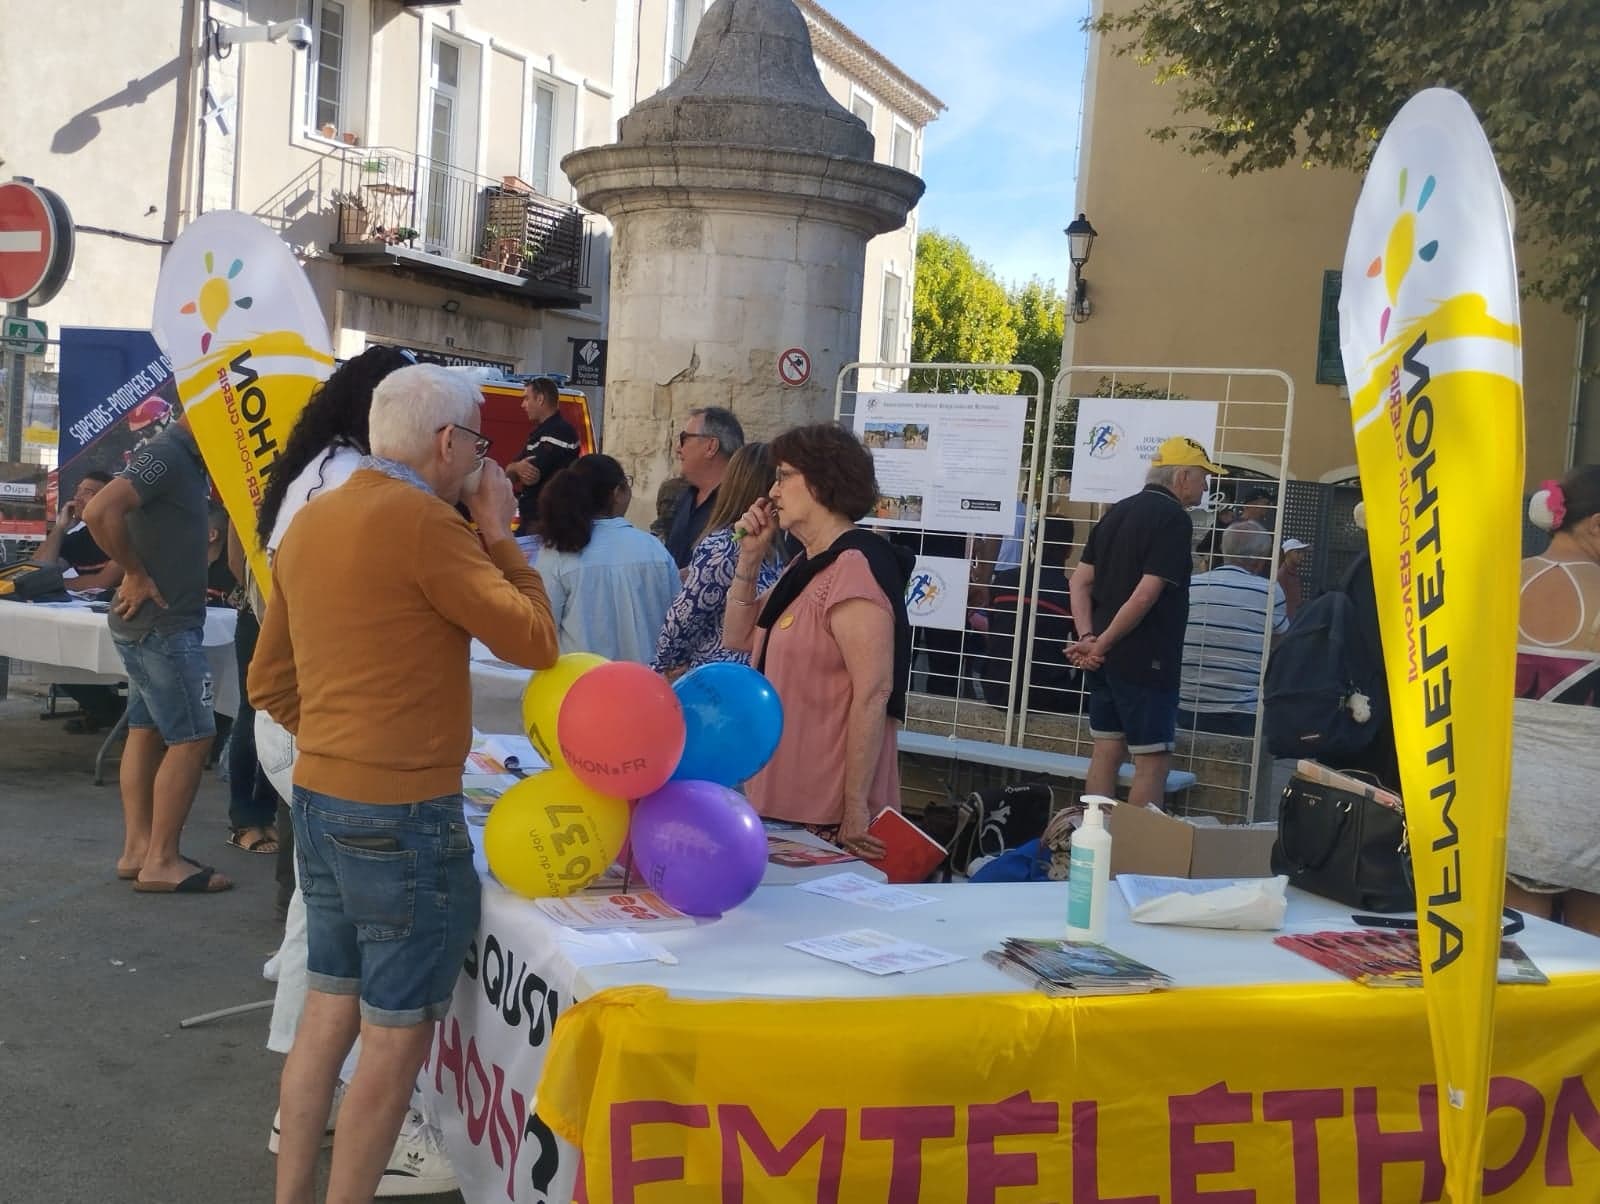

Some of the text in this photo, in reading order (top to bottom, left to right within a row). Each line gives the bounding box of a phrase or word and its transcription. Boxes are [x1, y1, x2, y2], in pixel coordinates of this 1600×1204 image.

[69, 360, 168, 446] SAPEURS-POMPIERS DU
[528, 827, 545, 852] don
[575, 1074, 1600, 1204] FMTÉLÉTHON
